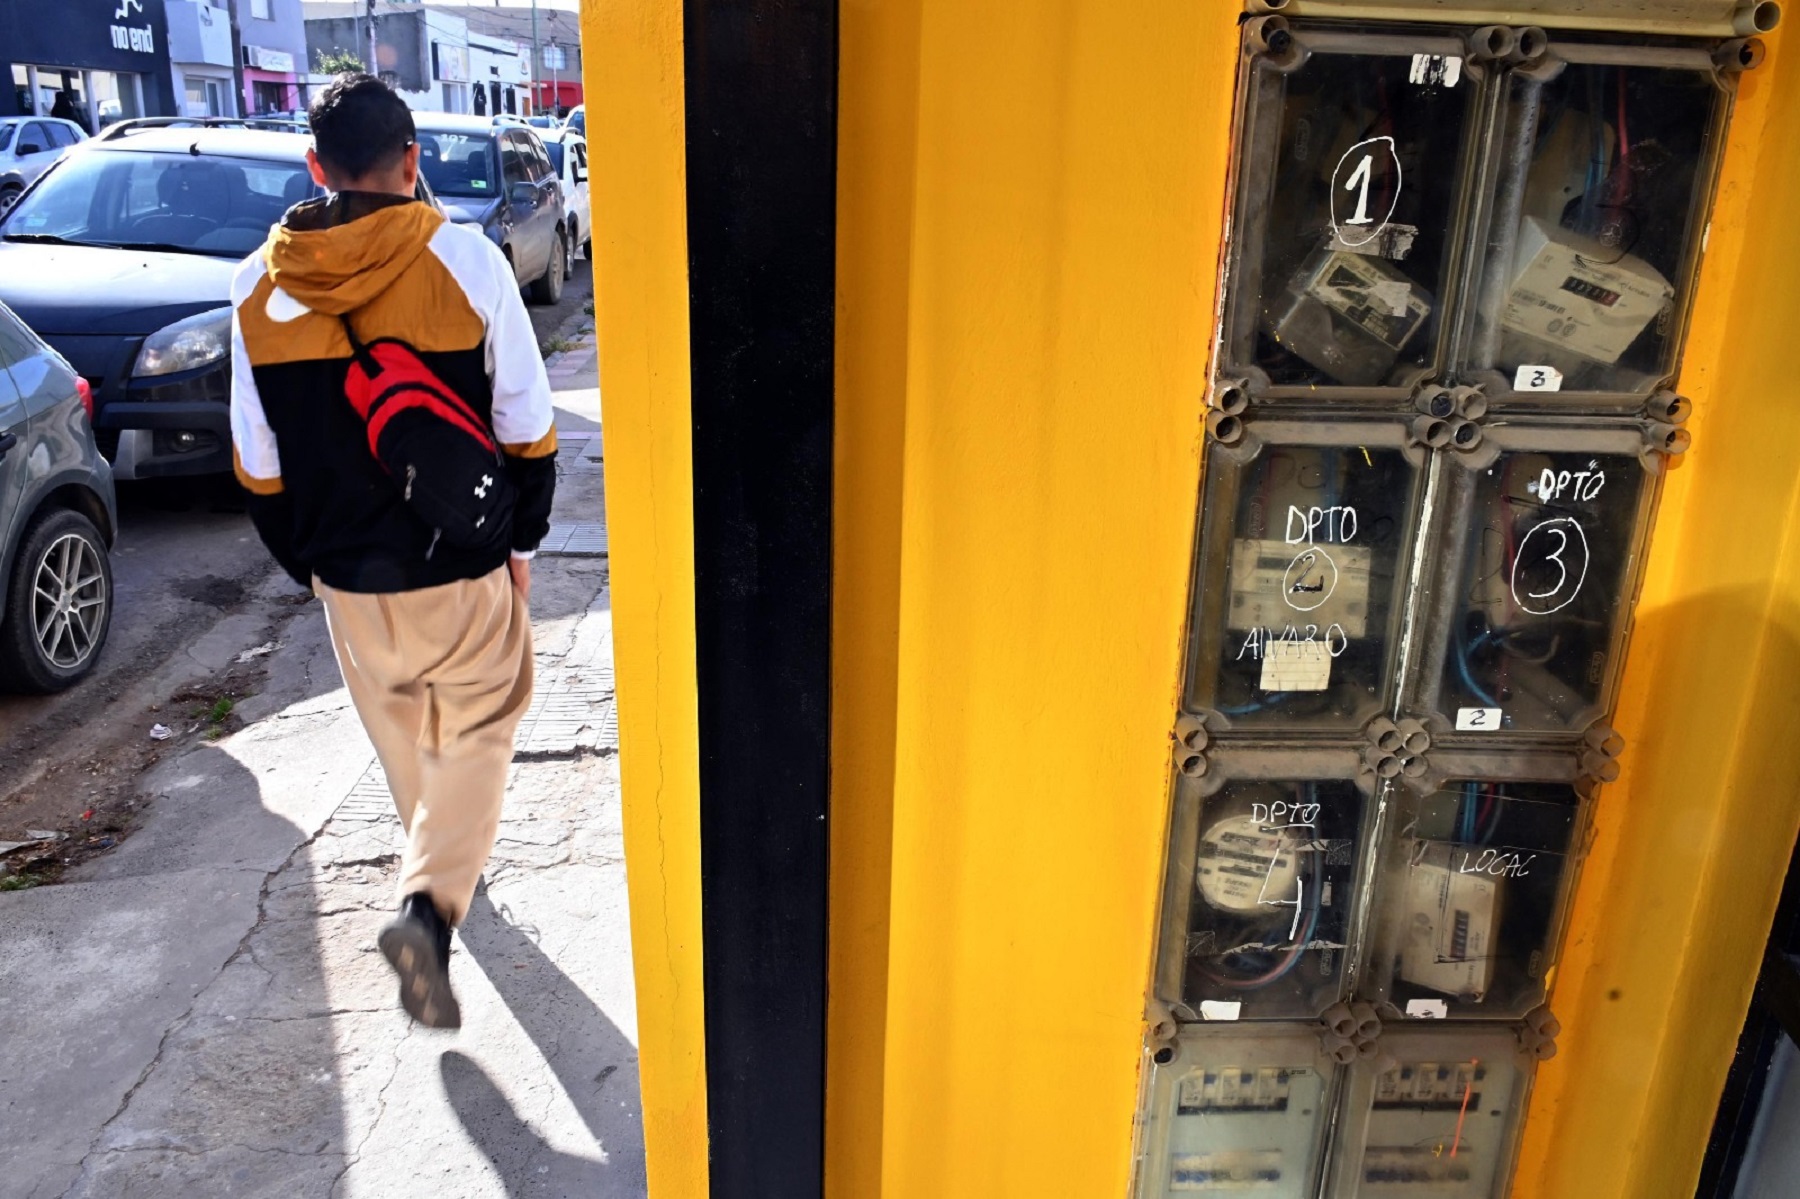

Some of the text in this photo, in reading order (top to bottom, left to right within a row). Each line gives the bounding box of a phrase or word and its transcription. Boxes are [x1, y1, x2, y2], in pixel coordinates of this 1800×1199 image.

[110, 24, 155, 53] no end
[1345, 154, 1374, 224] 1
[1530, 370, 1546, 388] 3
[1537, 467, 1605, 504] DPTO
[1285, 505, 1358, 545] DPTO
[1289, 552, 1325, 595] 2
[1528, 529, 1567, 598] 3
[1469, 708, 1488, 727] 2
[1250, 800, 1321, 824] DPTO
